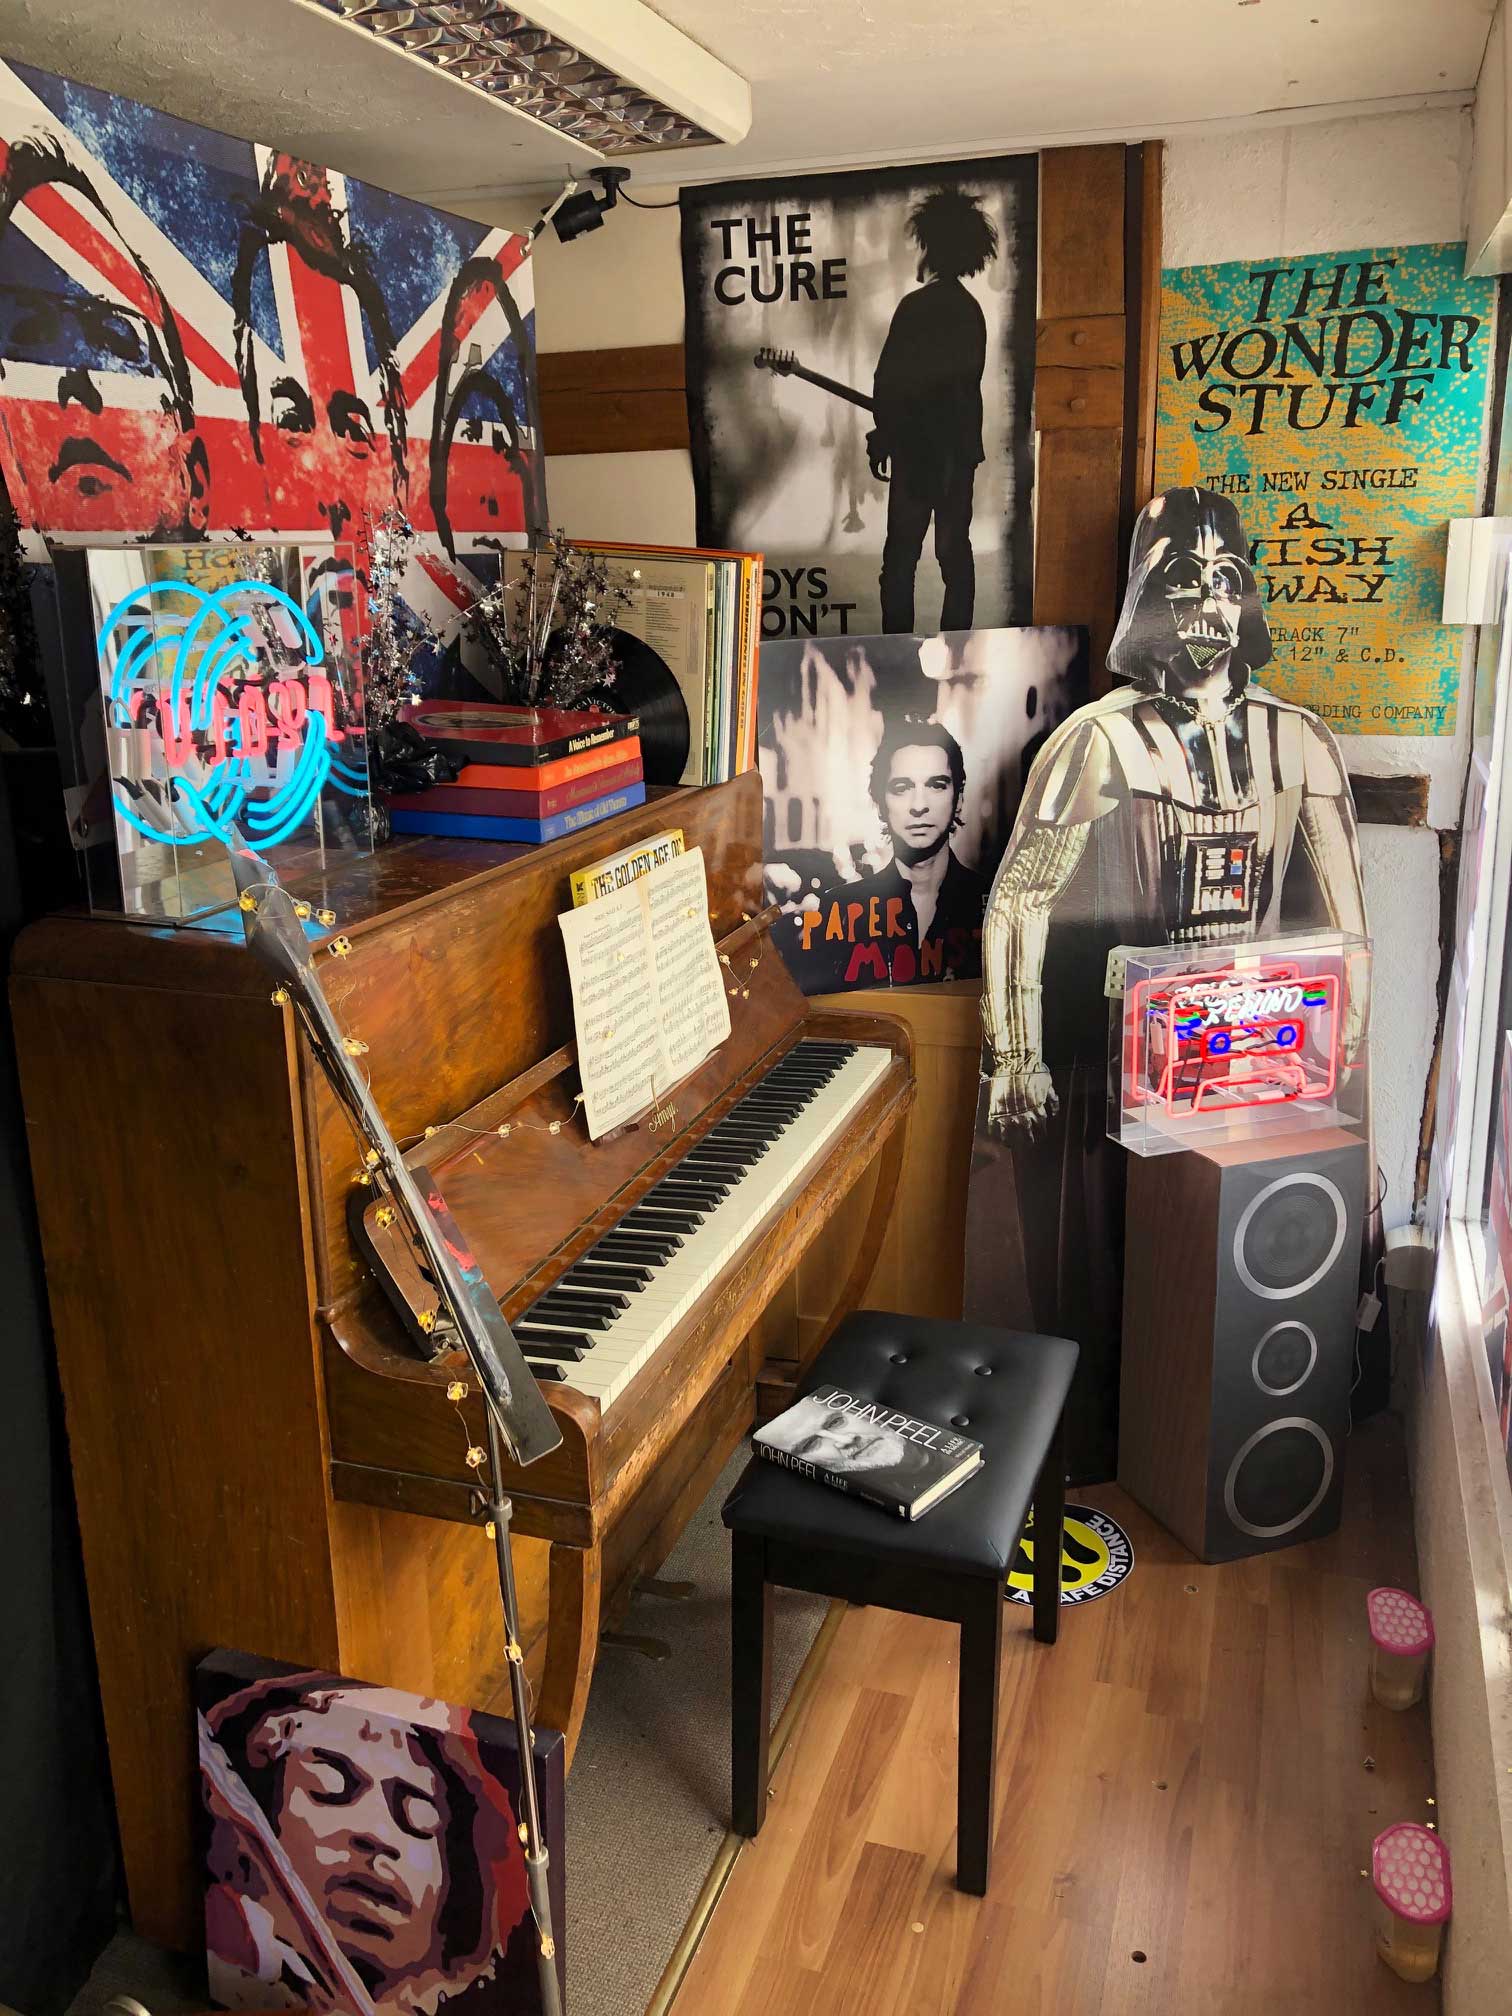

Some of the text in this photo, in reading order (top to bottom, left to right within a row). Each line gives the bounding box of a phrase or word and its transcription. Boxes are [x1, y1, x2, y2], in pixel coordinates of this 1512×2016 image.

[710, 213, 813, 260] THE
[714, 258, 847, 306] CURE
[1250, 259, 1397, 324] THE
[1170, 309, 1481, 381] WONDER
[1195, 373, 1435, 435] STUFF
[1207, 468, 1418, 494] THE NEW SINGLE
[1279, 502, 1333, 530] A
[762, 566, 828, 600] OYS
[1261, 573, 1395, 604] WAY
[761, 603, 856, 637] ON'T
[1335, 649, 1349, 663] &
[1360, 648, 1406, 664] C.D.
[1372, 705, 1448, 720] COMPANY
[573, 737, 586, 751] Voice
[590, 728, 615, 745] Remember
[591, 870, 615, 900] THE
[614, 852, 652, 890] GOLDEN
[802, 896, 906, 950] PAPER
[812, 1390, 884, 1424] JOHN
[879, 1413, 942, 1451] PEEL
[760, 1443, 789, 1469] JOHN
[1011, 1514, 1130, 1604] A AFE DISTANCE
